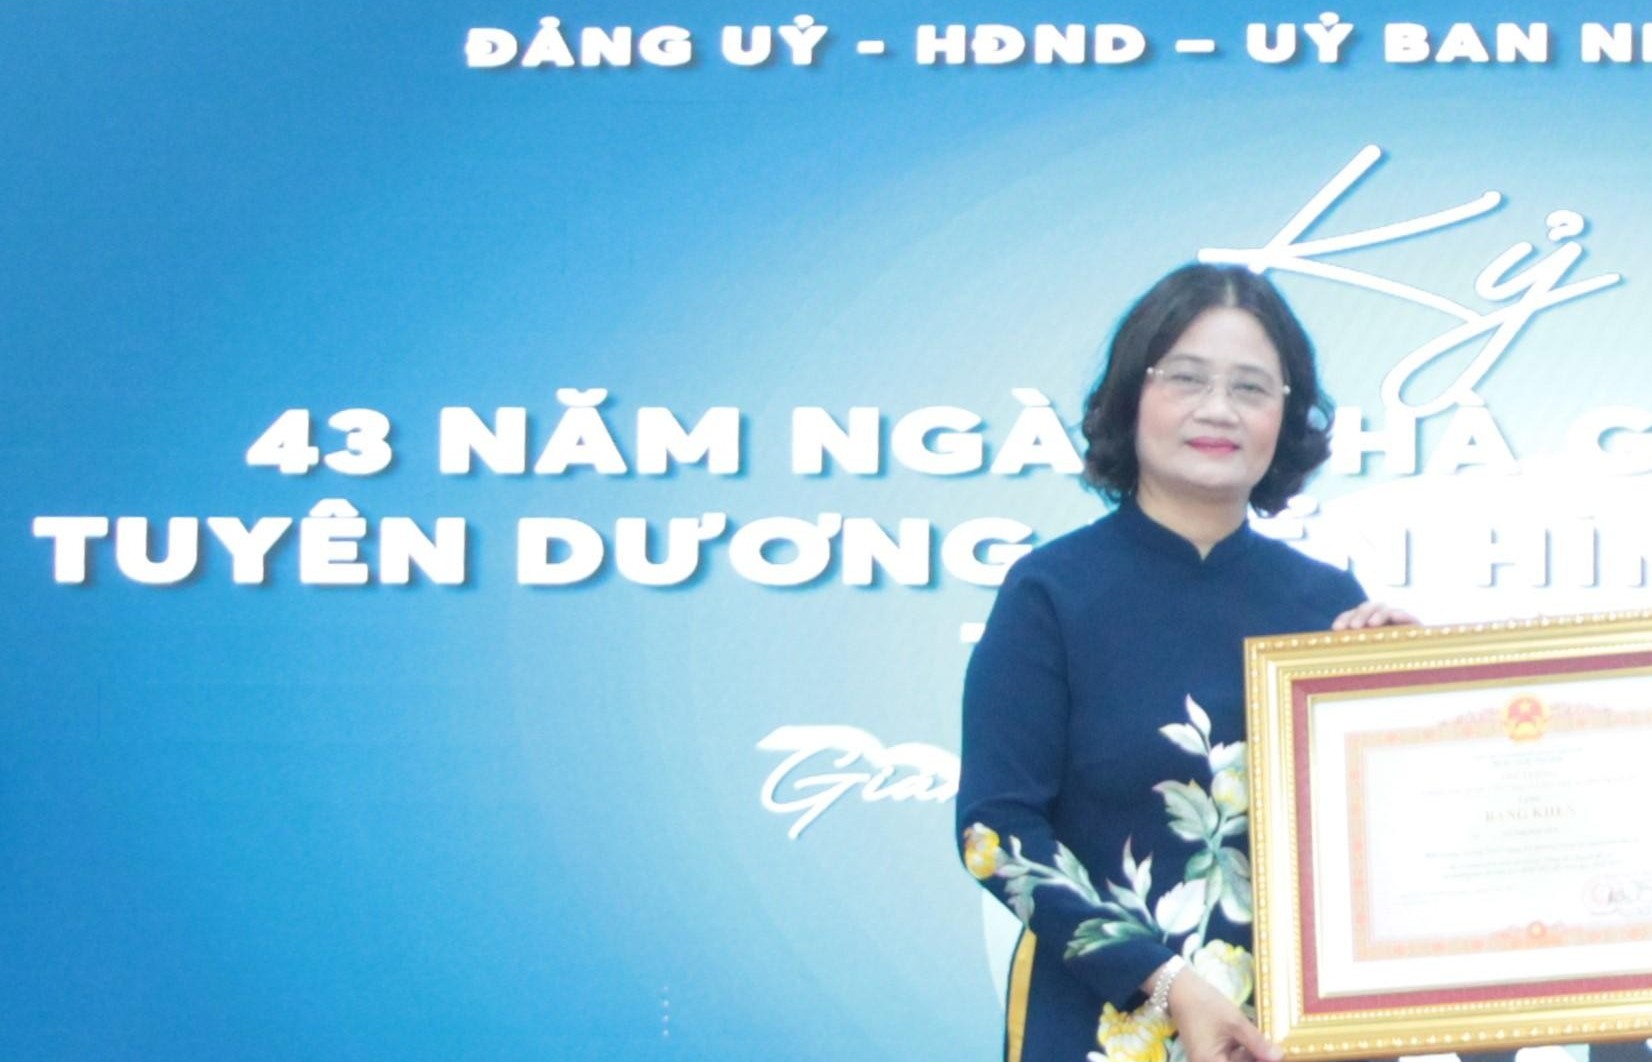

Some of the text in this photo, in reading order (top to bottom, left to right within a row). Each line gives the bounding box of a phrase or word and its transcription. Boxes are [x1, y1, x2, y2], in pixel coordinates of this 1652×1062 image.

[465, 16, 692, 67] ĐẢNG
[722, 14, 827, 66] UỶ
[916, 24, 1146, 64] HĐND
[1247, 12, 1353, 63] UỶ
[1384, 22, 1548, 62] BAN
[1197, 143, 1622, 418] Kỷ
[247, 409, 391, 473] 43
[441, 389, 739, 473] NĂM
[792, 387, 1083, 474] NGÀ
[1328, 387, 1523, 475] HÀ
[34, 499, 465, 583] TUYÊN
[518, 512, 1032, 585] DƯƠNG
